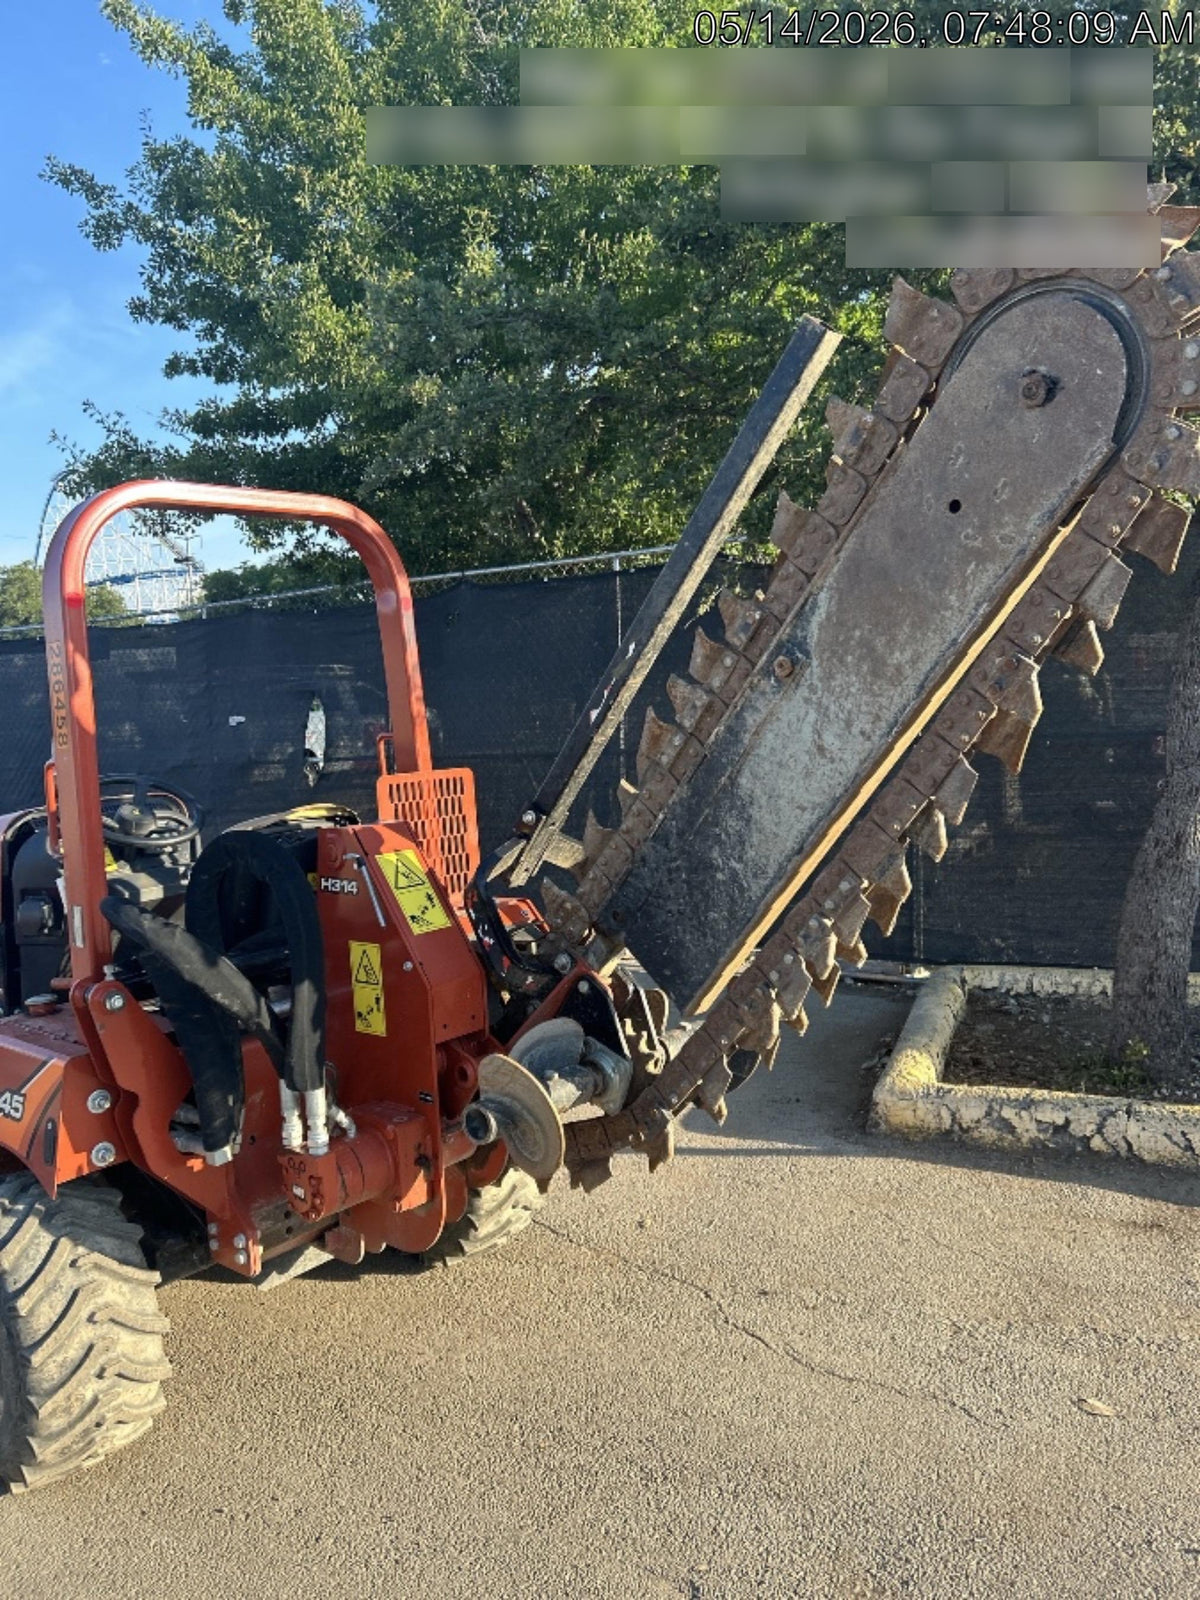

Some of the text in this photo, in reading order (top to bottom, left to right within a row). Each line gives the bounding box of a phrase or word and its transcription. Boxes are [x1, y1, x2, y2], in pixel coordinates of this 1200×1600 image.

[48, 641, 68, 747] 286458
[320, 878, 358, 894] H314
[0, 1091, 24, 1118] 45
